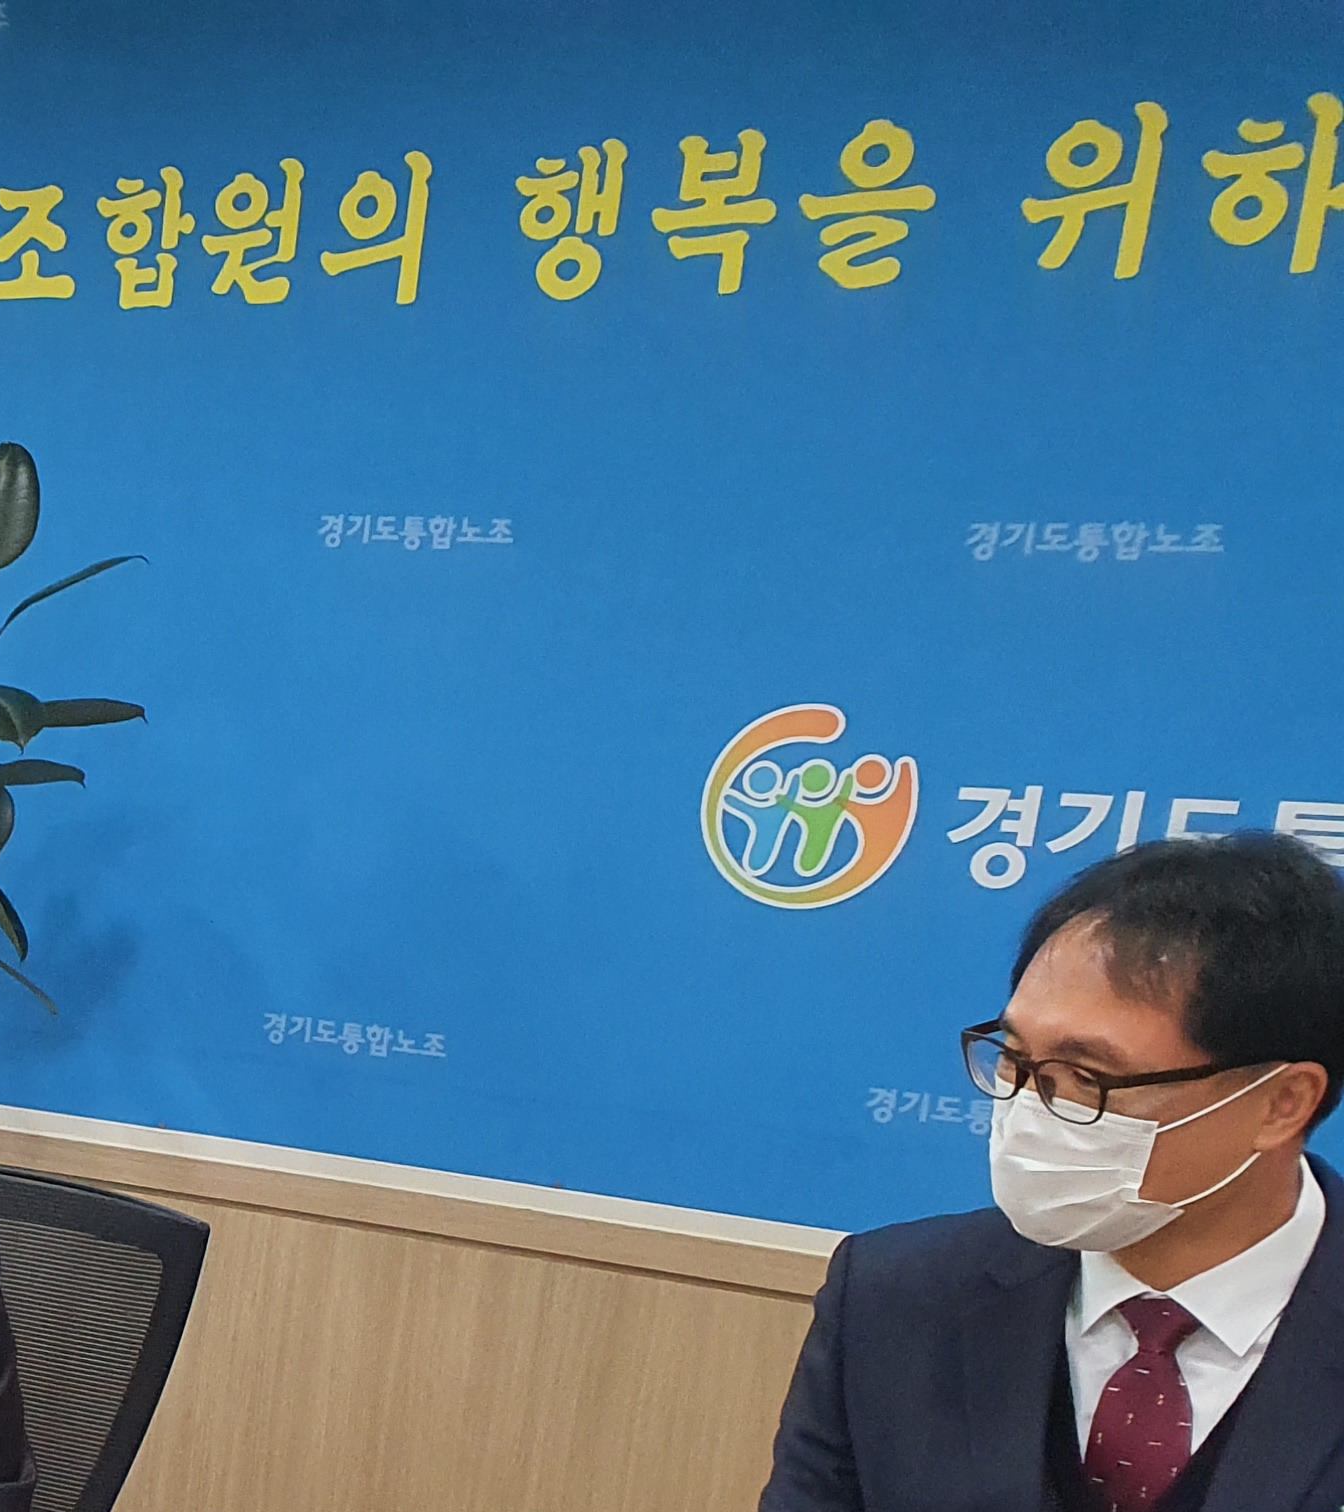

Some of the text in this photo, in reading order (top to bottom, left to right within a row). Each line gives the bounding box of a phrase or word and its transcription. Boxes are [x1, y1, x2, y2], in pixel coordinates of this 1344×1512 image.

[515, 118, 936, 301] 행복을
[1021, 91, 1344, 280] 위하
[318, 514, 514, 551] 경기도통합노조
[964, 520, 1224, 562] 경기도통합노조
[263, 1012, 447, 1058] 경기도통합노조
